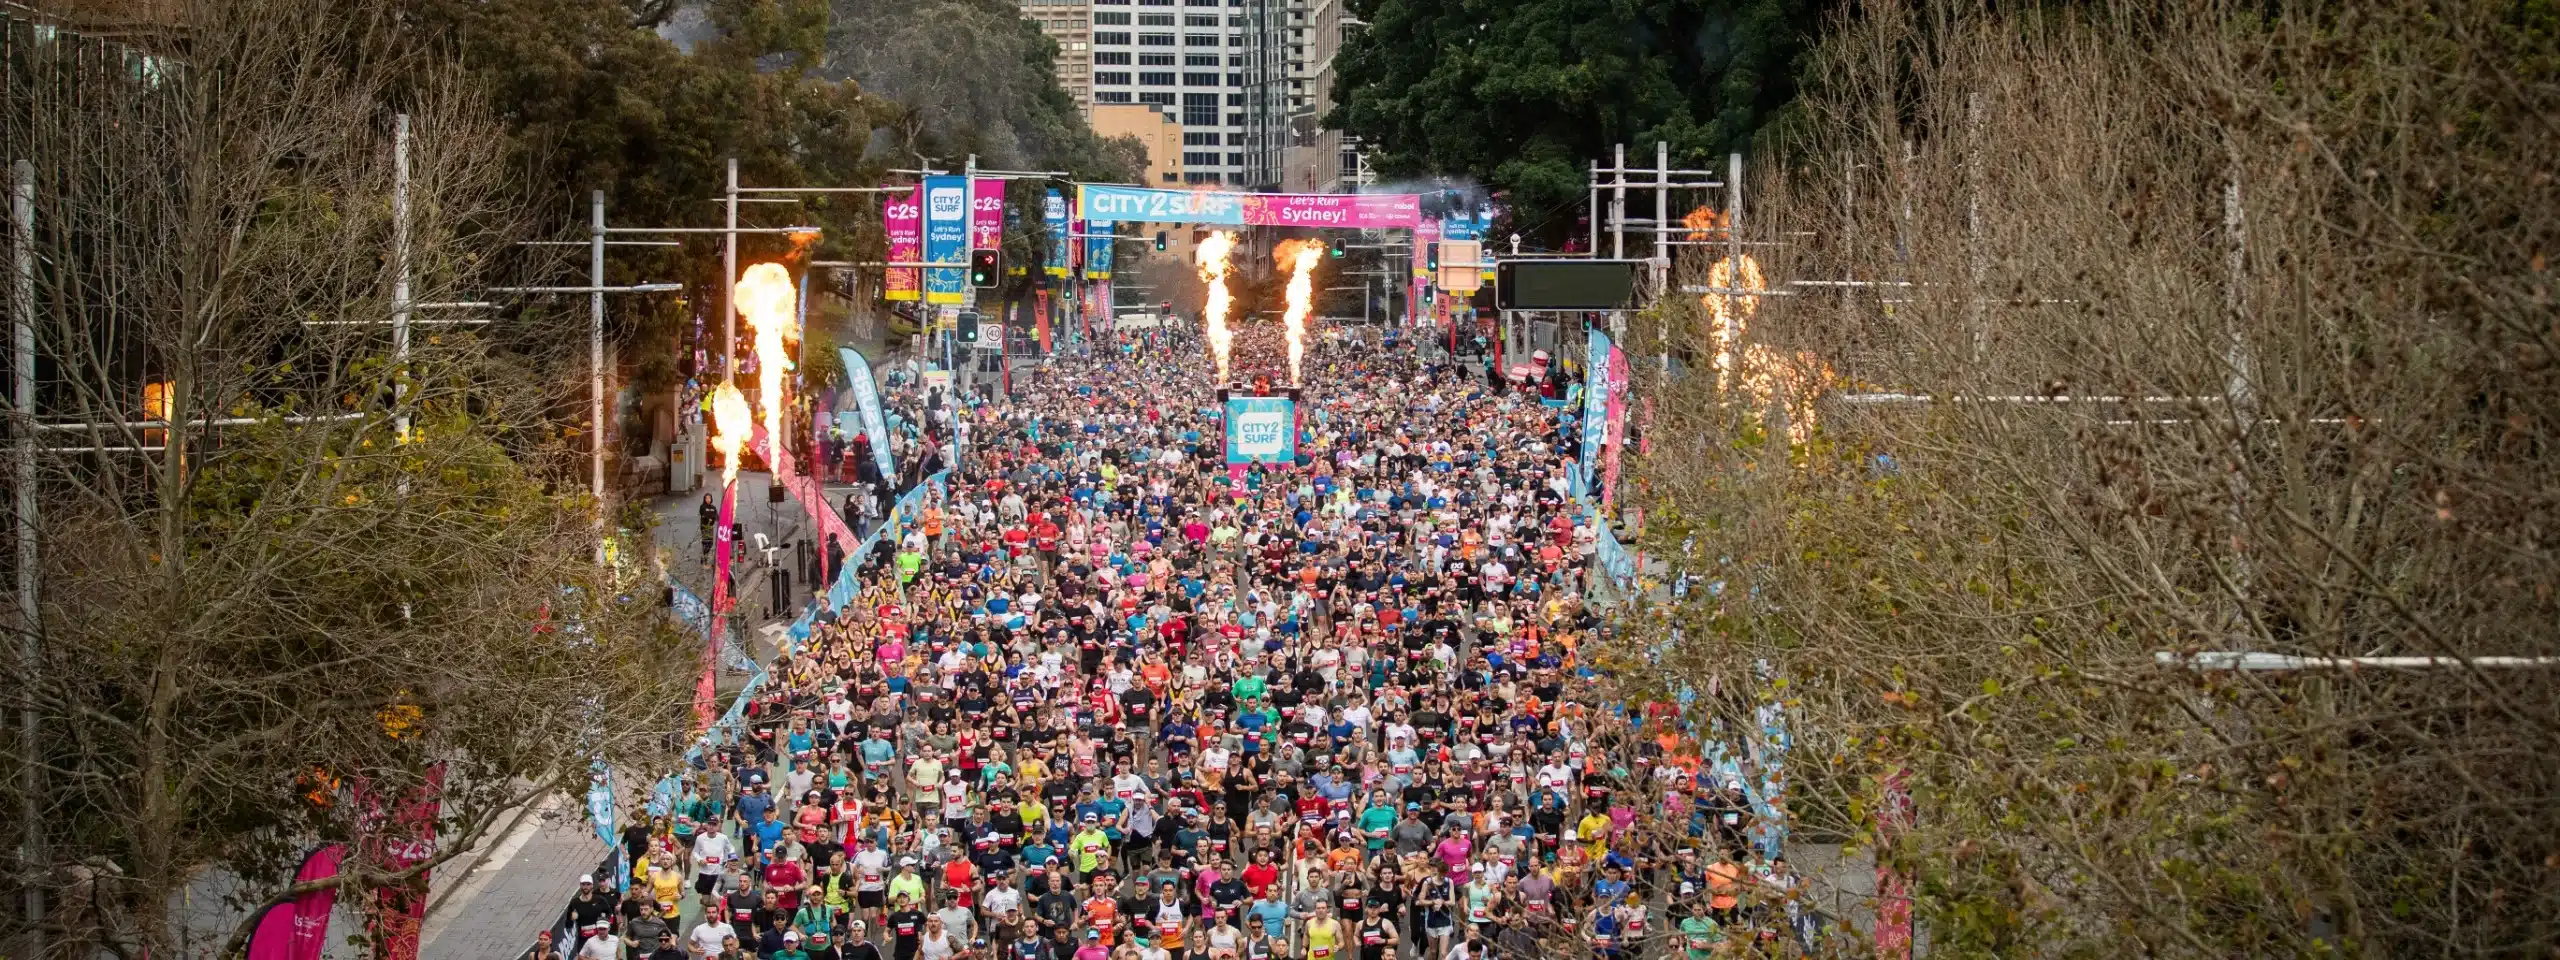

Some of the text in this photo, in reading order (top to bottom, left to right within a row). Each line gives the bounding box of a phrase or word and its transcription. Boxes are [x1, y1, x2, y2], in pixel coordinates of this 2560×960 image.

[933, 195, 961, 204] CITY2
[1290, 195, 1339, 207] Let's Run
[935, 205, 959, 213] SURF
[1282, 207, 1347, 224] Sydney!
[930, 232, 965, 242] Sydney!
[989, 329, 1000, 338] 40
[1242, 421, 1279, 433] CITY2
[1244, 433, 1277, 444] SURF
